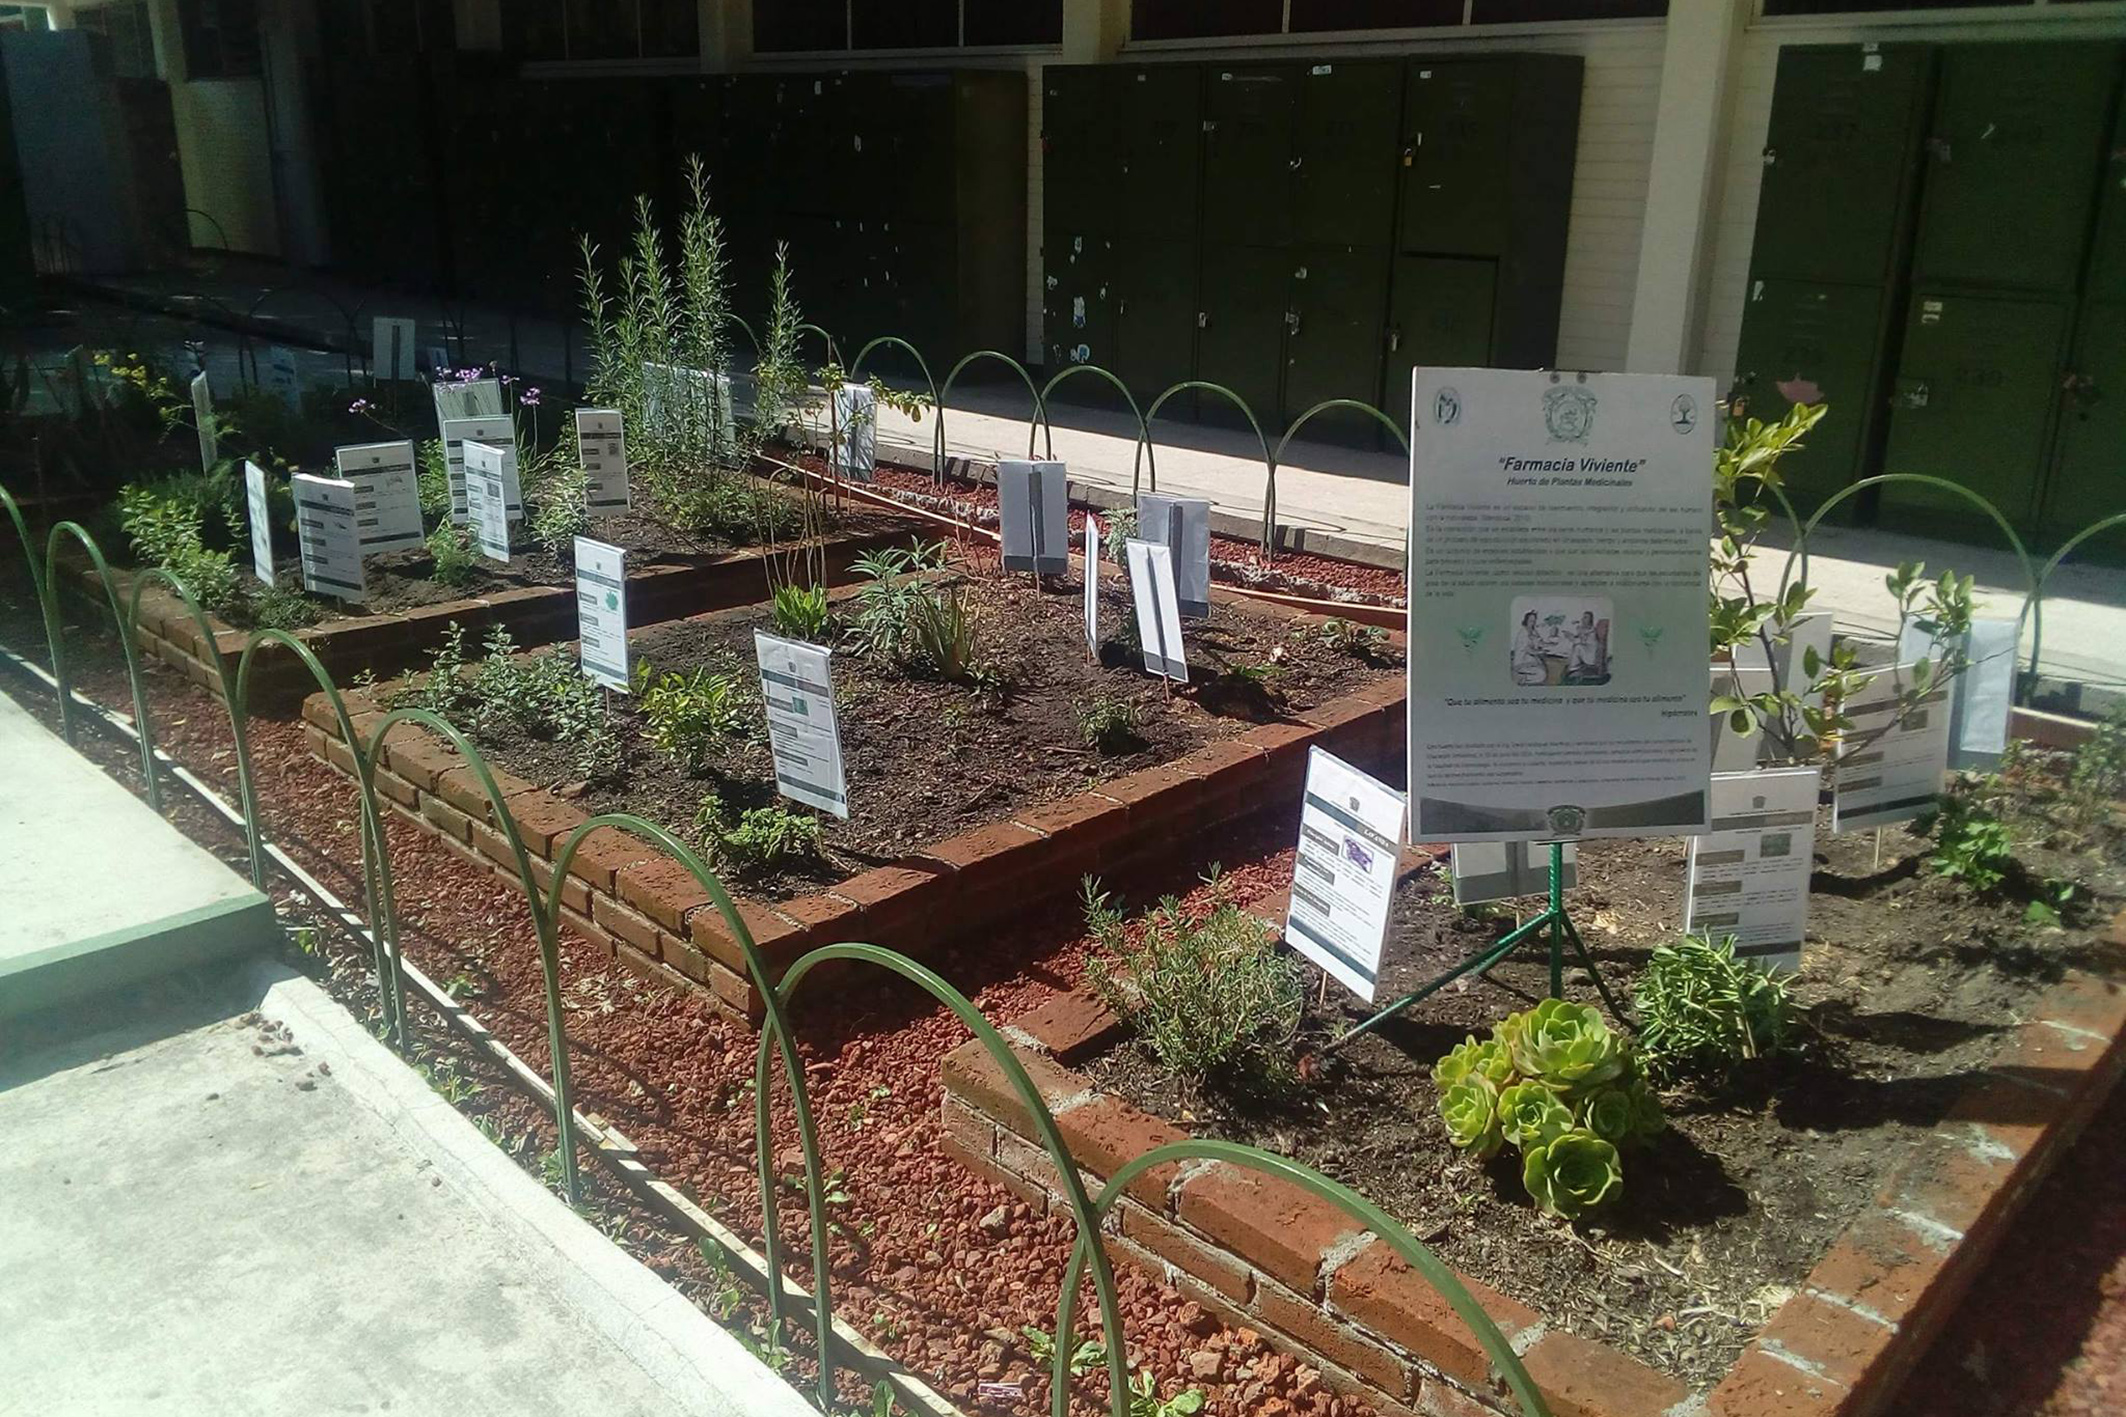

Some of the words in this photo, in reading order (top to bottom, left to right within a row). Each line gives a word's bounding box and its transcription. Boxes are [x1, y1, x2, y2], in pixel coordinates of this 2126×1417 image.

[1507, 477, 1537, 486] Huerto
[1539, 477, 1549, 486] de
[1551, 477, 1582, 486] Plantas
[1584, 478, 1633, 487] Medicinales
